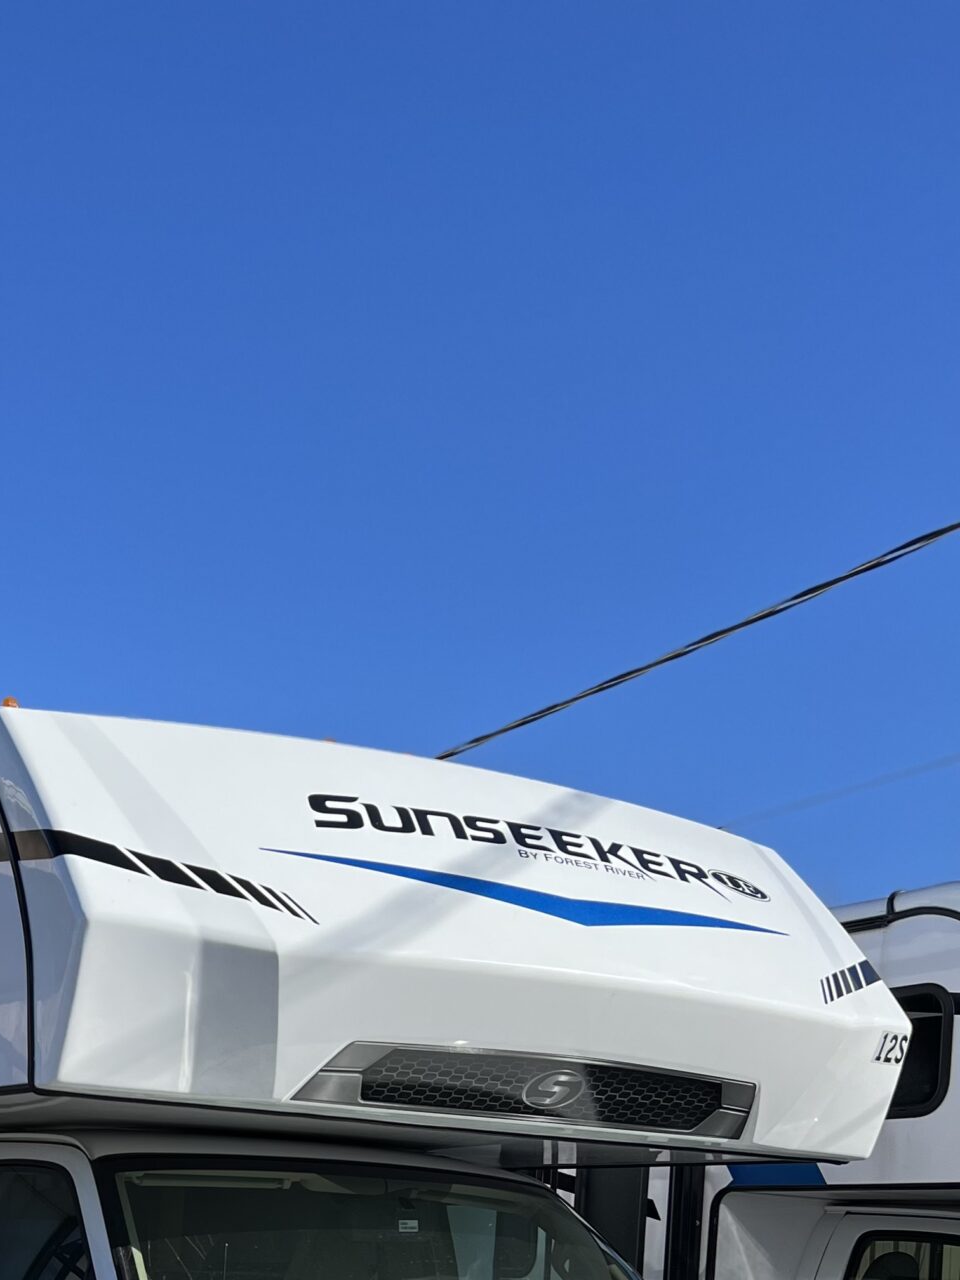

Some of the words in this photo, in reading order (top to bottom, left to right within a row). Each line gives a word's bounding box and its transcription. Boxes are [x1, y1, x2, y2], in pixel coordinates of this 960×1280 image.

[517, 849, 539, 860] BY
[544, 853, 600, 871] FOREST
[604, 864, 646, 881] RIVER
[874, 1032, 909, 1064] 12S
[526, 1074, 581, 1104] S
